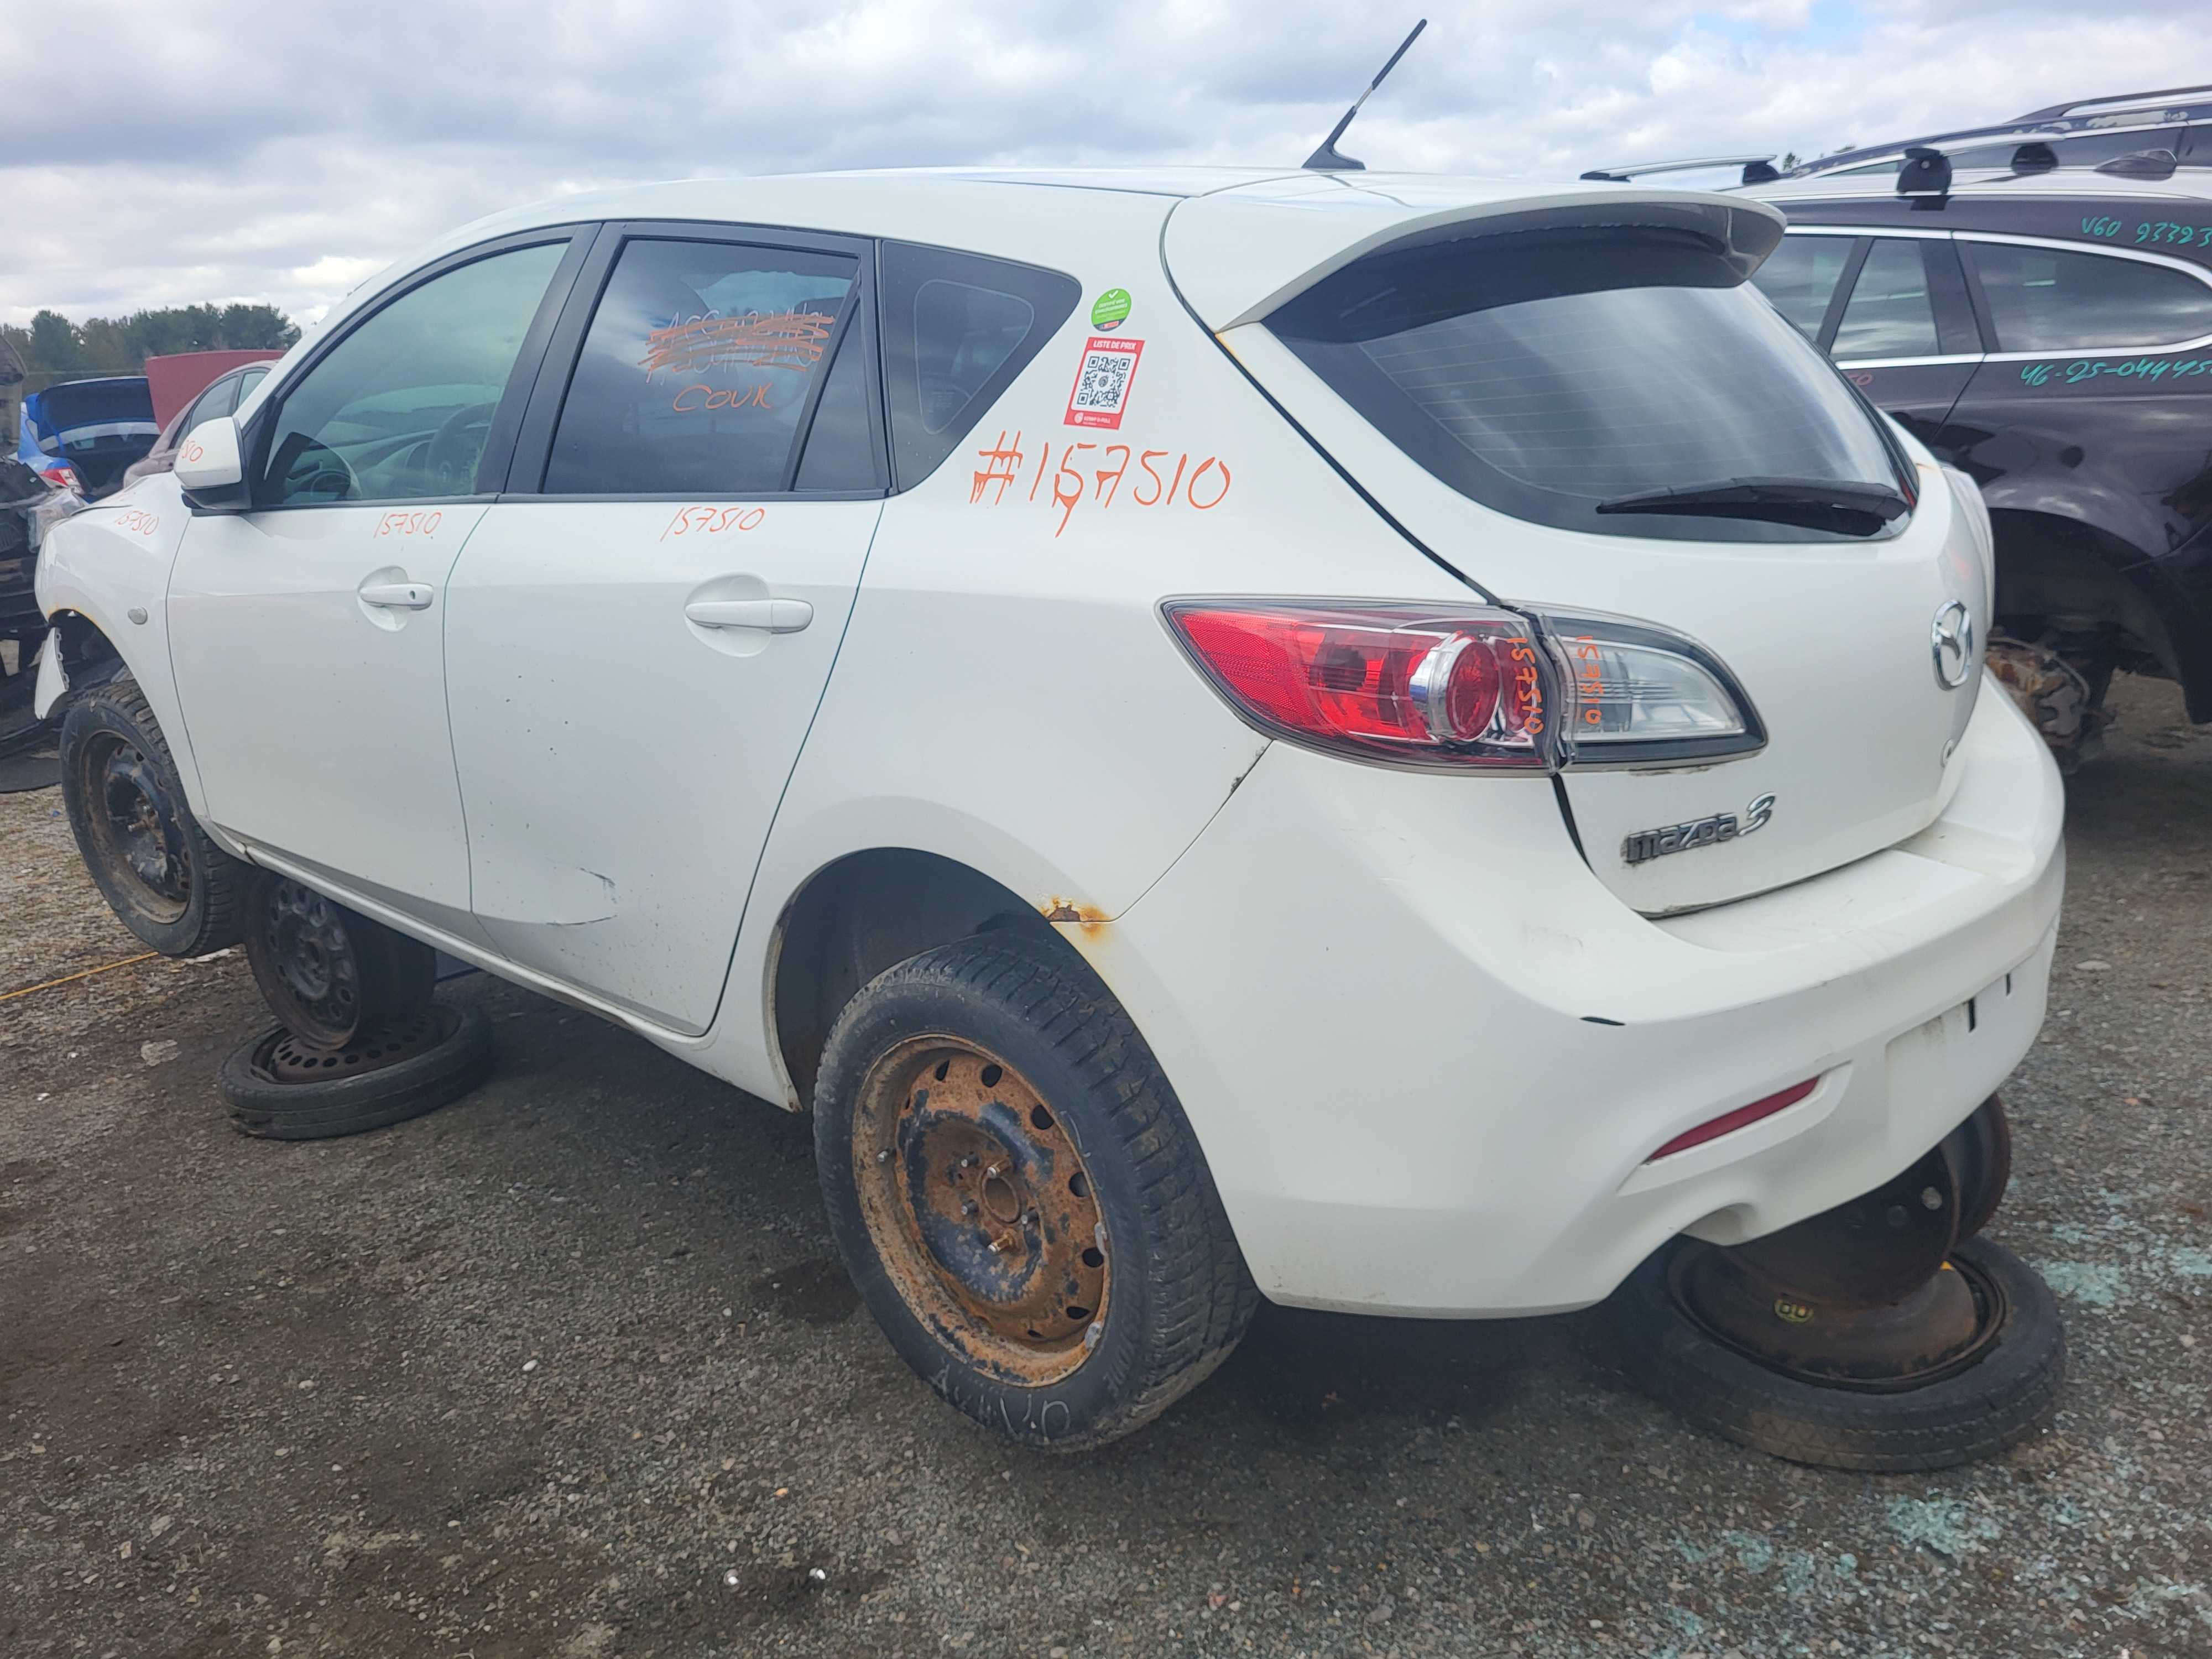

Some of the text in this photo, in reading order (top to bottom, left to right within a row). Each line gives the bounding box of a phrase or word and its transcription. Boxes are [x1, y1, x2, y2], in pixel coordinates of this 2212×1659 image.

[2081, 216, 2122, 237] V60
[1093, 340, 1136, 350] LISTE DE PRIX
[2021, 358, 2211, 386] 46-25-04445
[969, 430, 1231, 538] #157510
[373, 512, 442, 539] 157510
[660, 507, 765, 542] 157510
[1506, 637, 1544, 735] 157510
[1577, 635, 1604, 725] 157510
